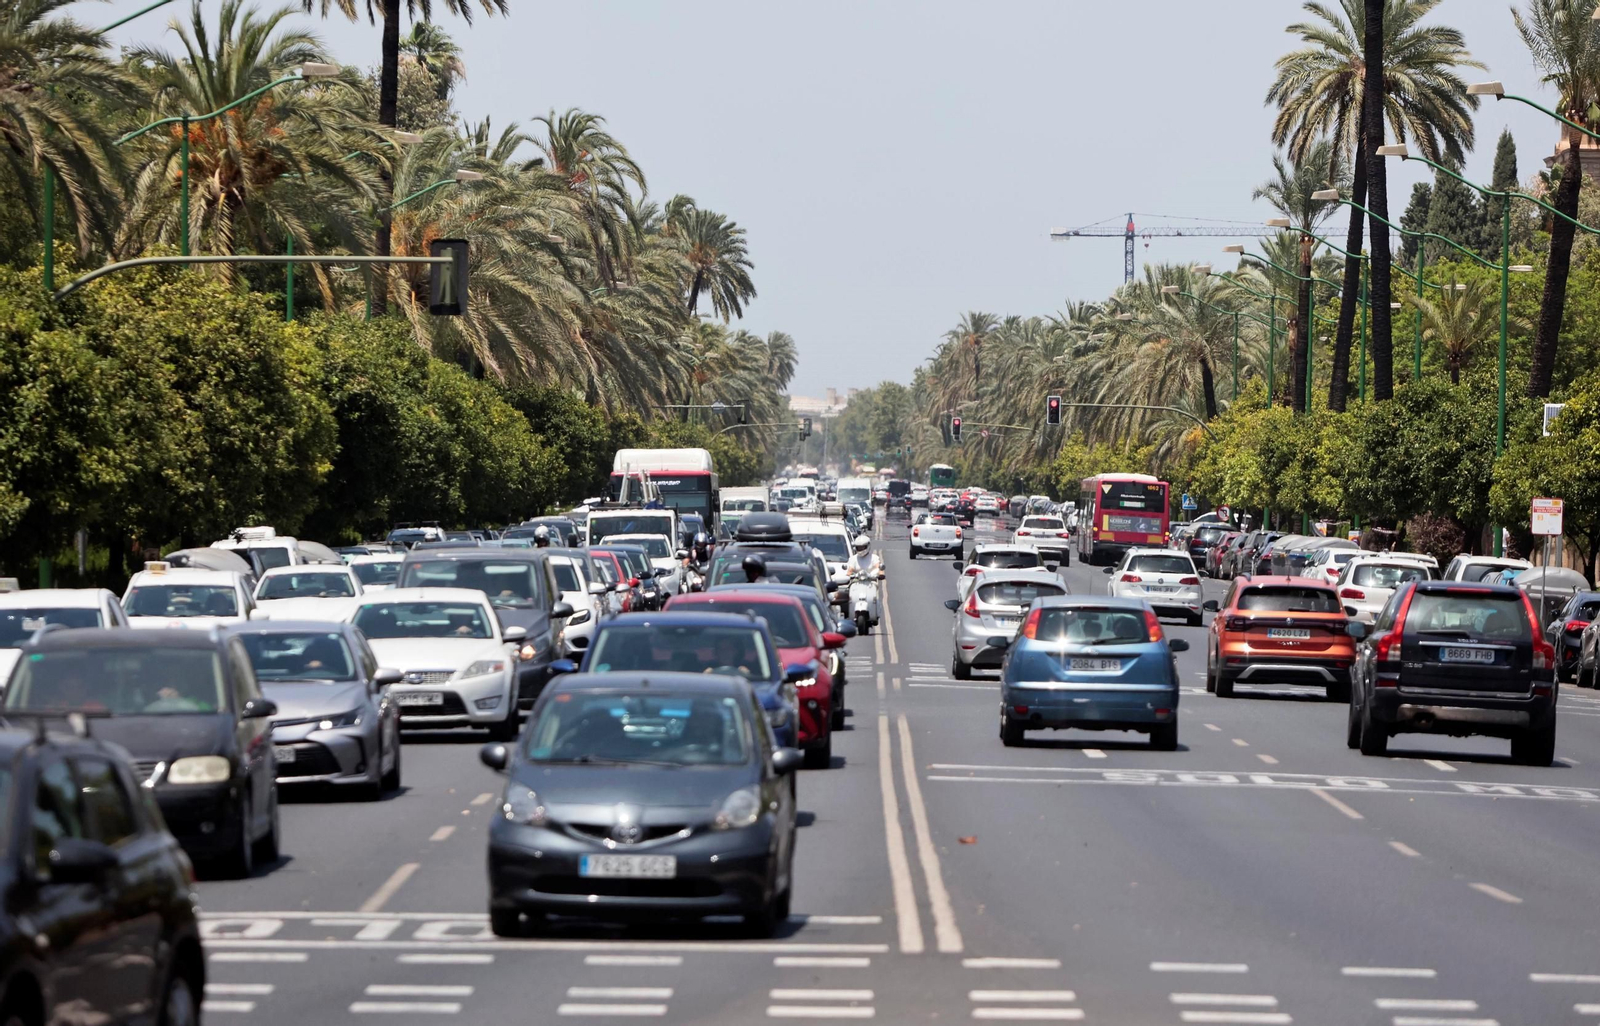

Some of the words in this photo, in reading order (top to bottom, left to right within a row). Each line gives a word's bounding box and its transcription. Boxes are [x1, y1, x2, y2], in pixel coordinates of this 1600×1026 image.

[1272, 629, 1292, 637] 4620
[1447, 648, 1472, 659] 8669
[1474, 650, 1493, 660] FHB
[1072, 659, 1095, 669] 2084
[1101, 771, 1391, 789] SOLO
